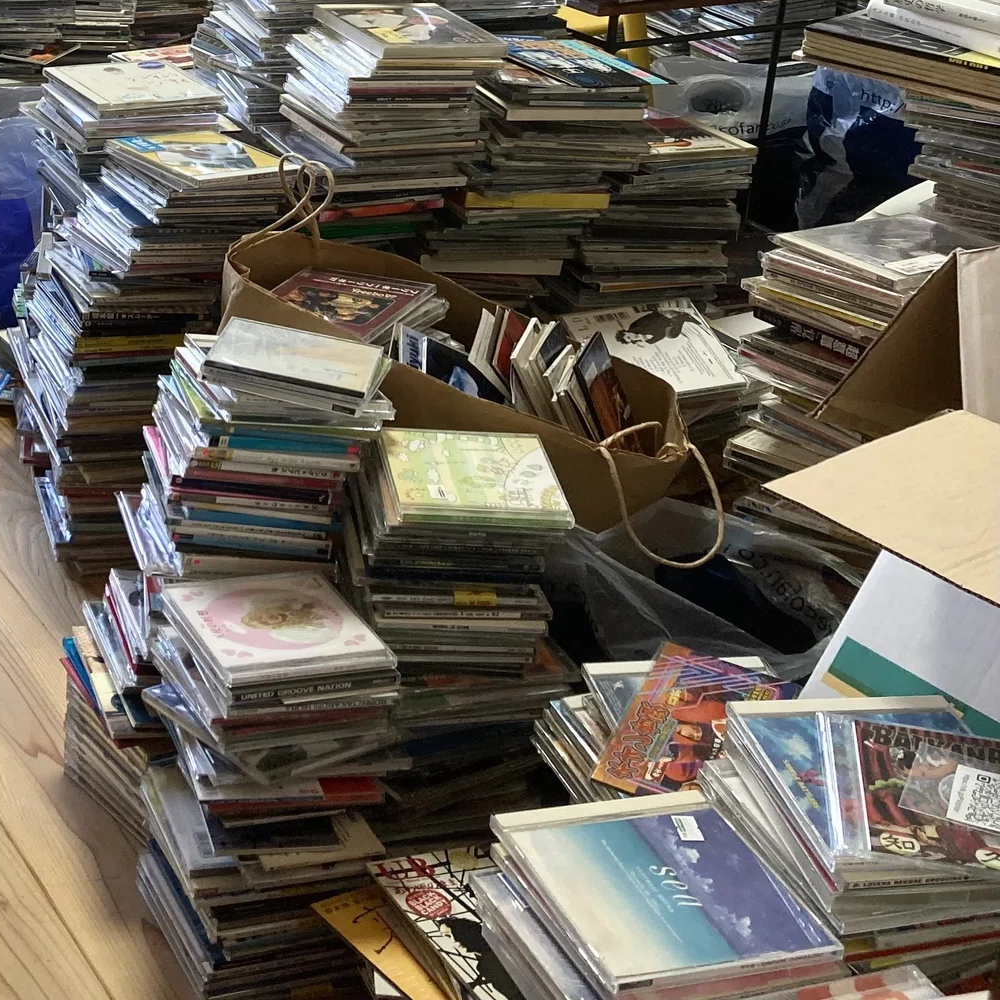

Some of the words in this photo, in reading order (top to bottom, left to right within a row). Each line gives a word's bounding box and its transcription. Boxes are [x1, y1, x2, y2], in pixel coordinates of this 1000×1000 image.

[240, 691, 275, 700] UNITED
[277, 686, 314, 697] GROOVE
[317, 681, 352, 692] NATION
[881, 834, 915, 851] 知
